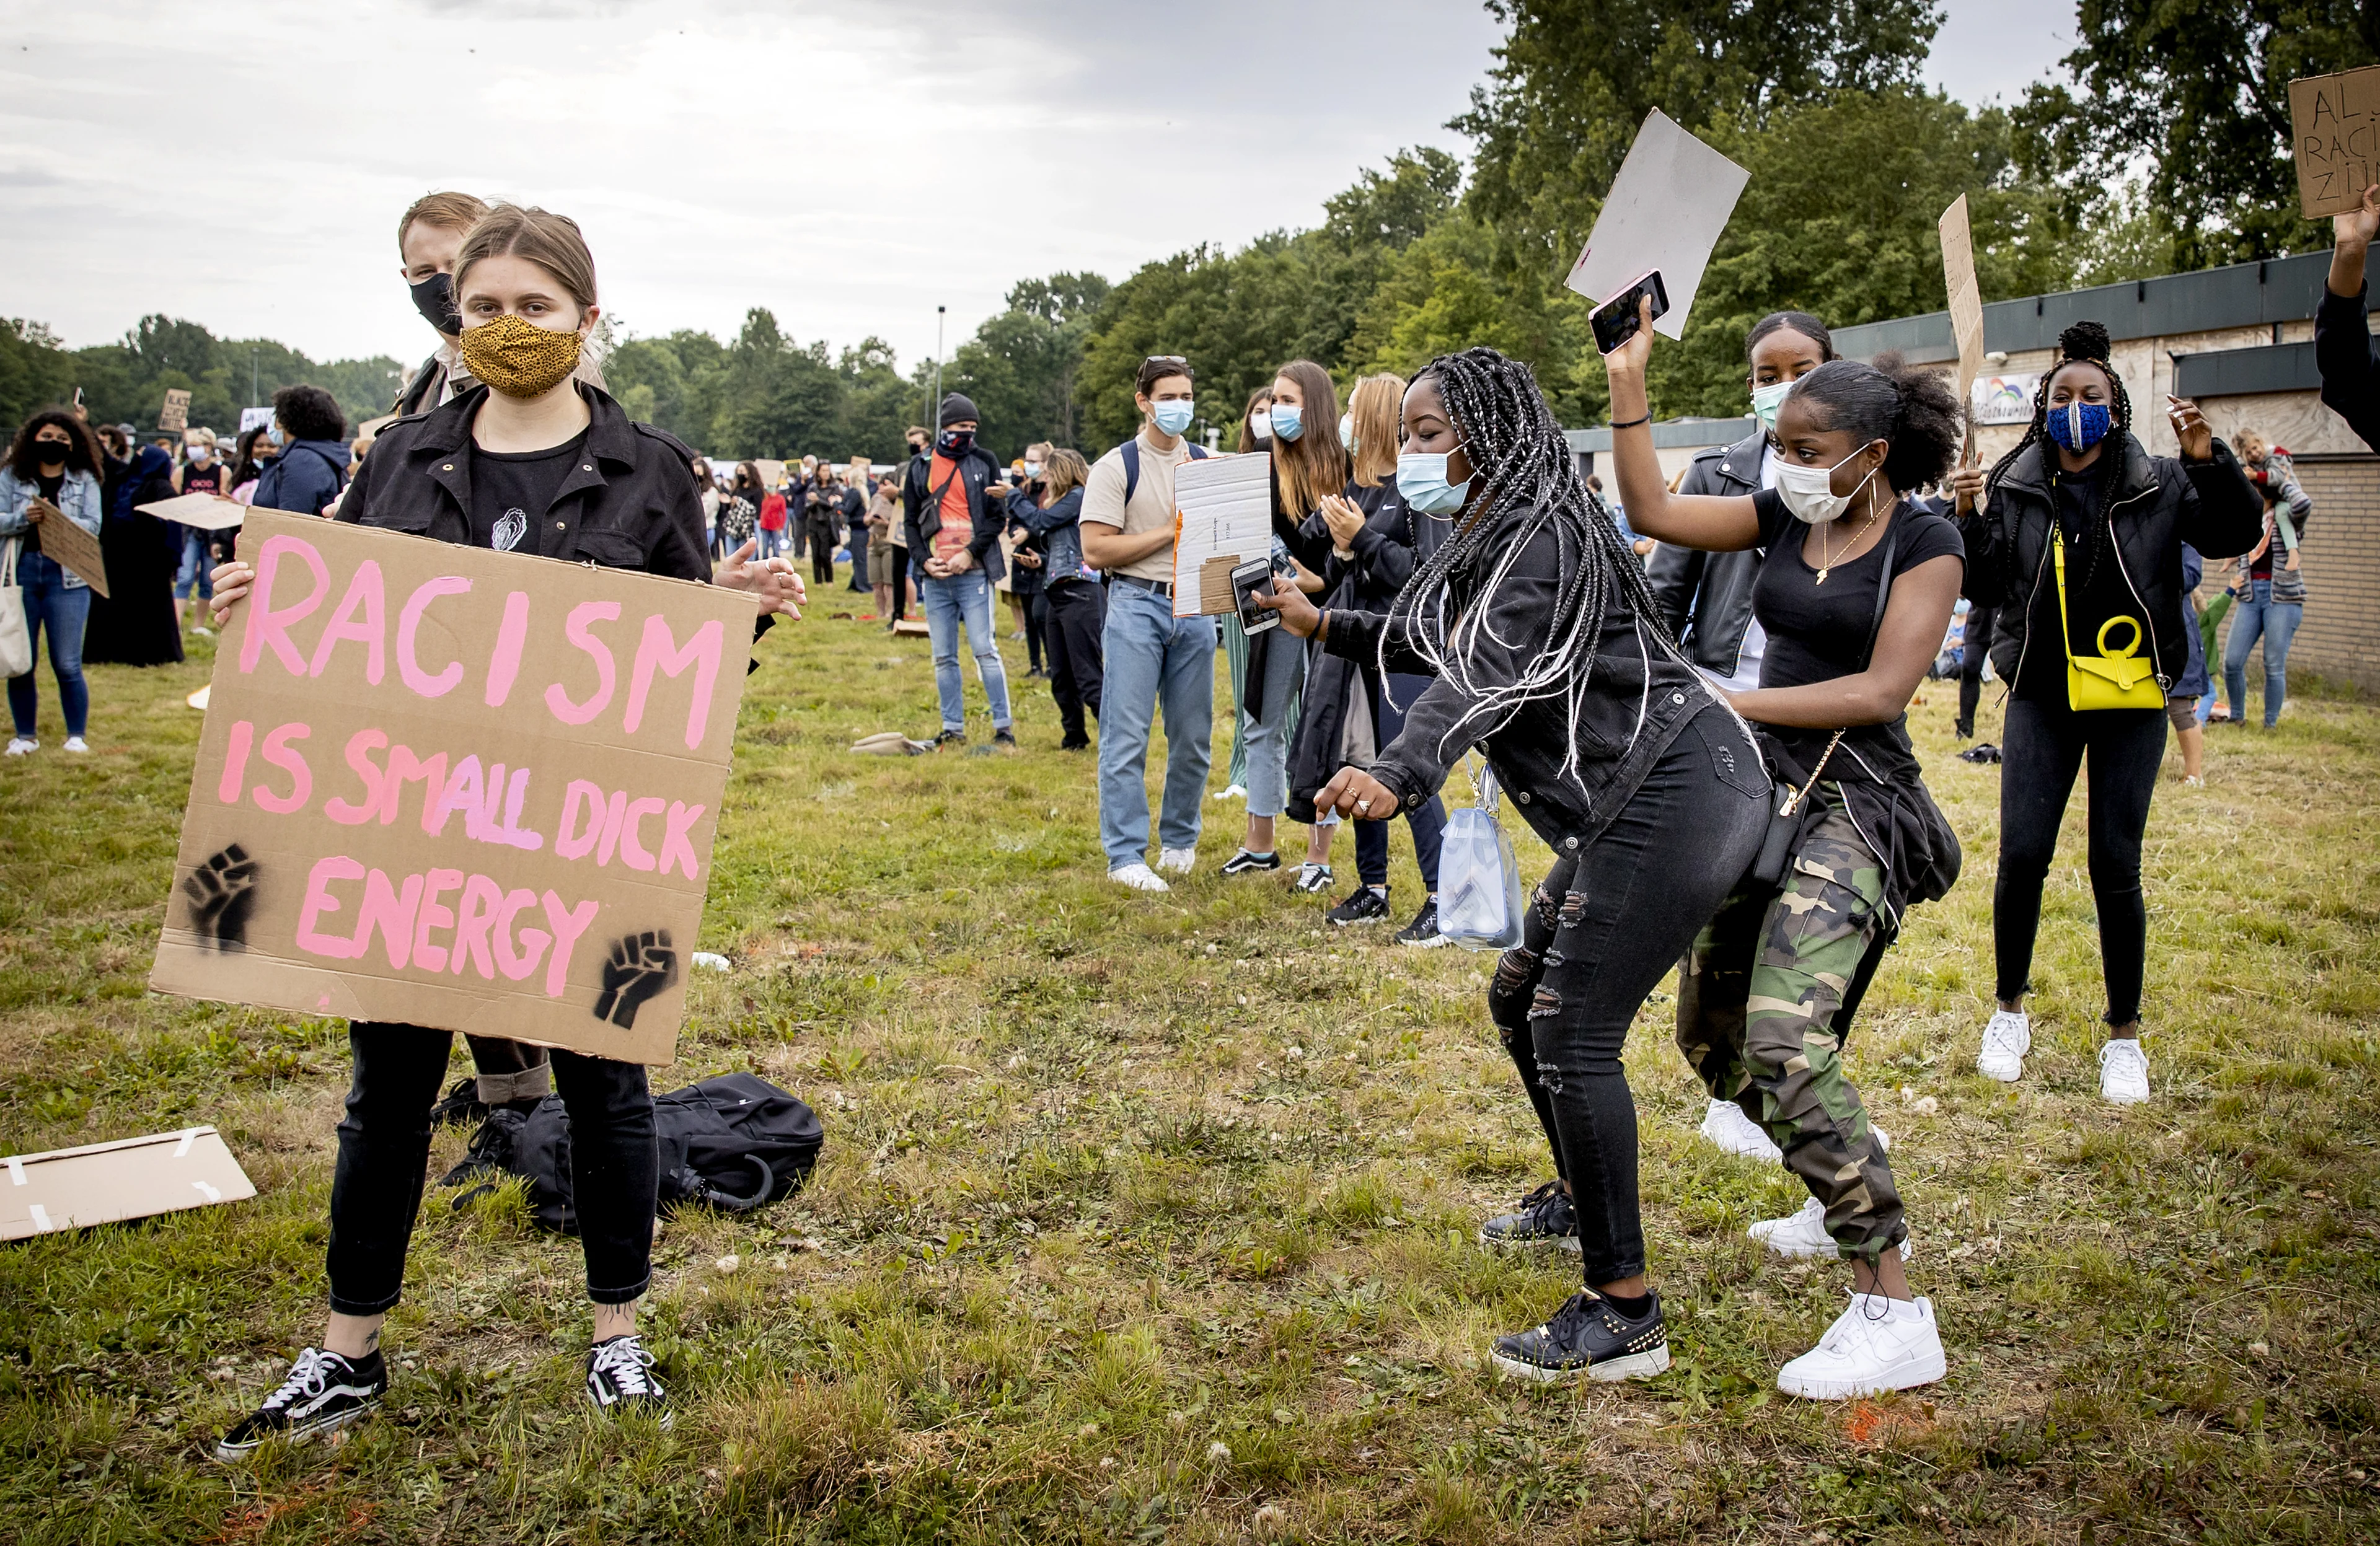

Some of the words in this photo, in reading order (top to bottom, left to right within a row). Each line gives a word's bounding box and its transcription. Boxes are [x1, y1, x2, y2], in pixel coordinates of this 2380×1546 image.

[2313, 82, 2361, 130] AL
[2312, 160, 2380, 201] ZIJ
[239, 534, 723, 750] RACISM
[218, 720, 312, 814] IS
[325, 727, 544, 851] SMALL
[555, 778, 706, 881] DICK
[296, 855, 599, 998] ENERGY
